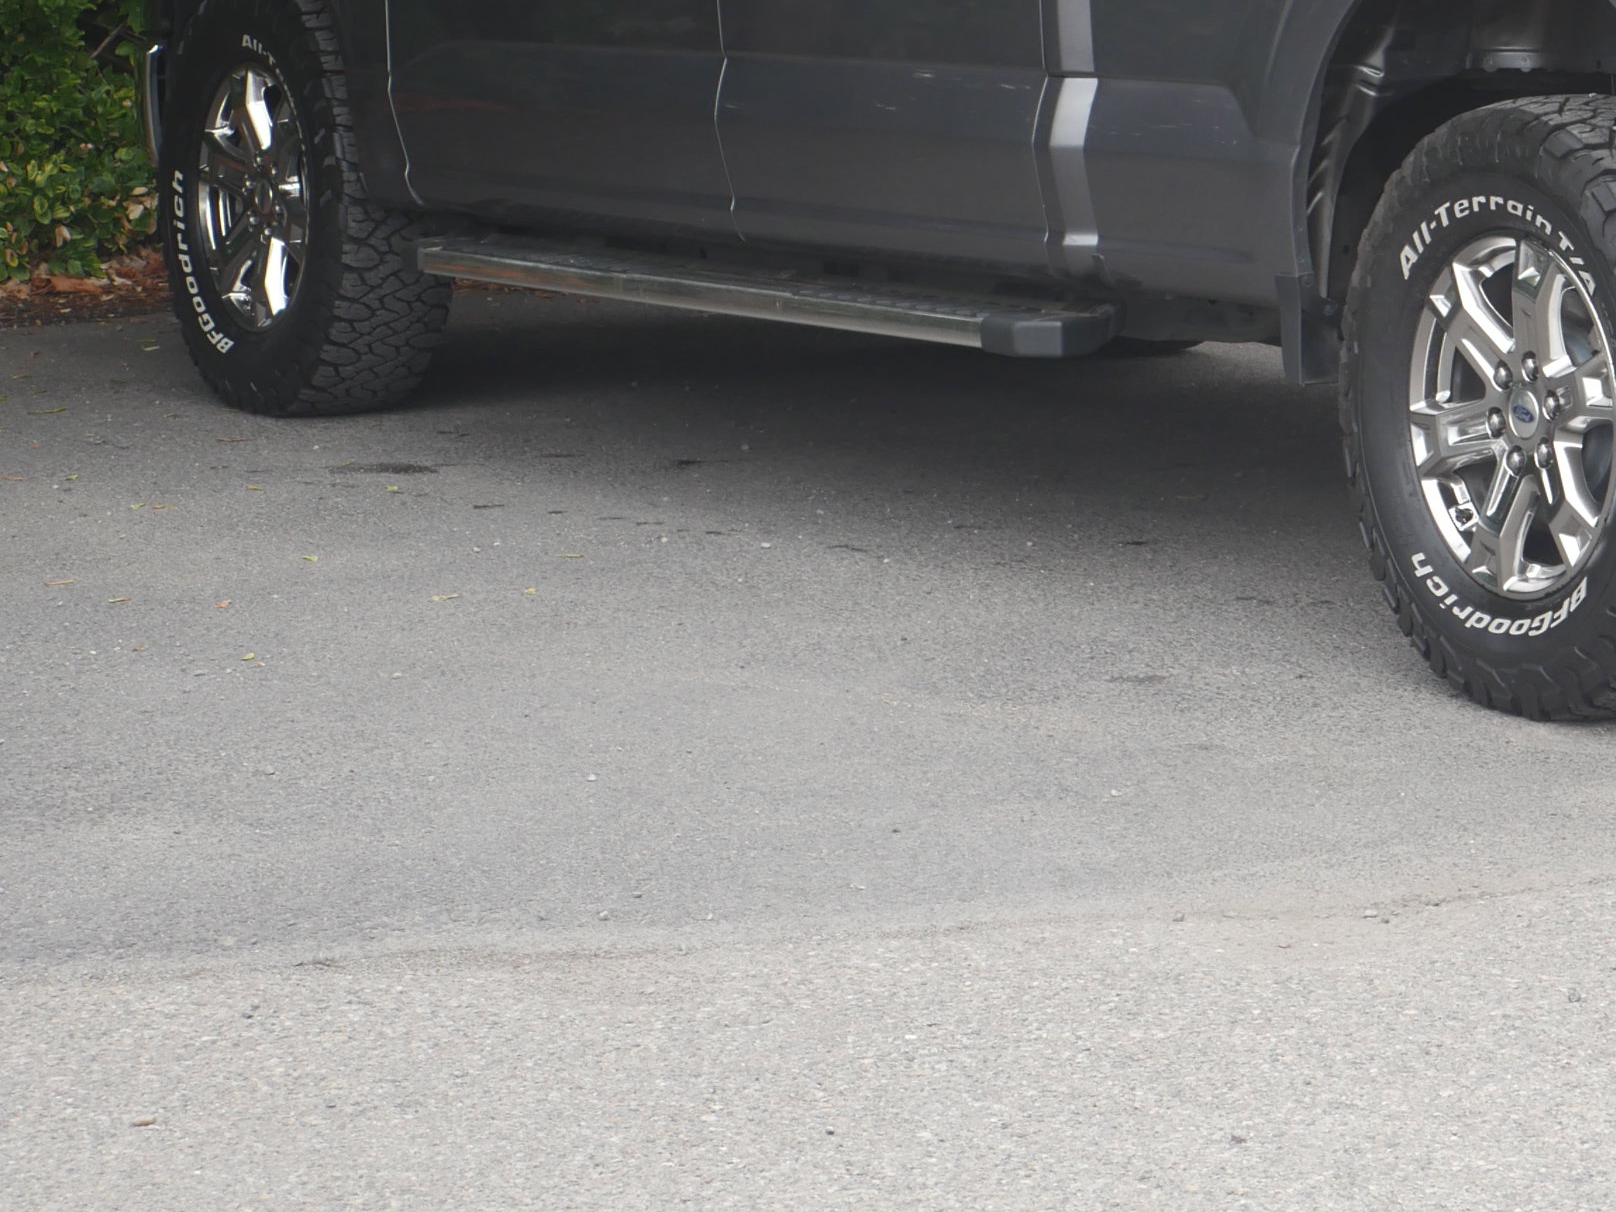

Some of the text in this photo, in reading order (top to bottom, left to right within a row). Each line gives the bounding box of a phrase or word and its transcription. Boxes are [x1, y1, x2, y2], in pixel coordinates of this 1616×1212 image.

[171, 169, 234, 354] BFGoodrich
[1400, 195, 1596, 297] All-Terrain T/A
[1411, 552, 1588, 637] BFGoodrich
